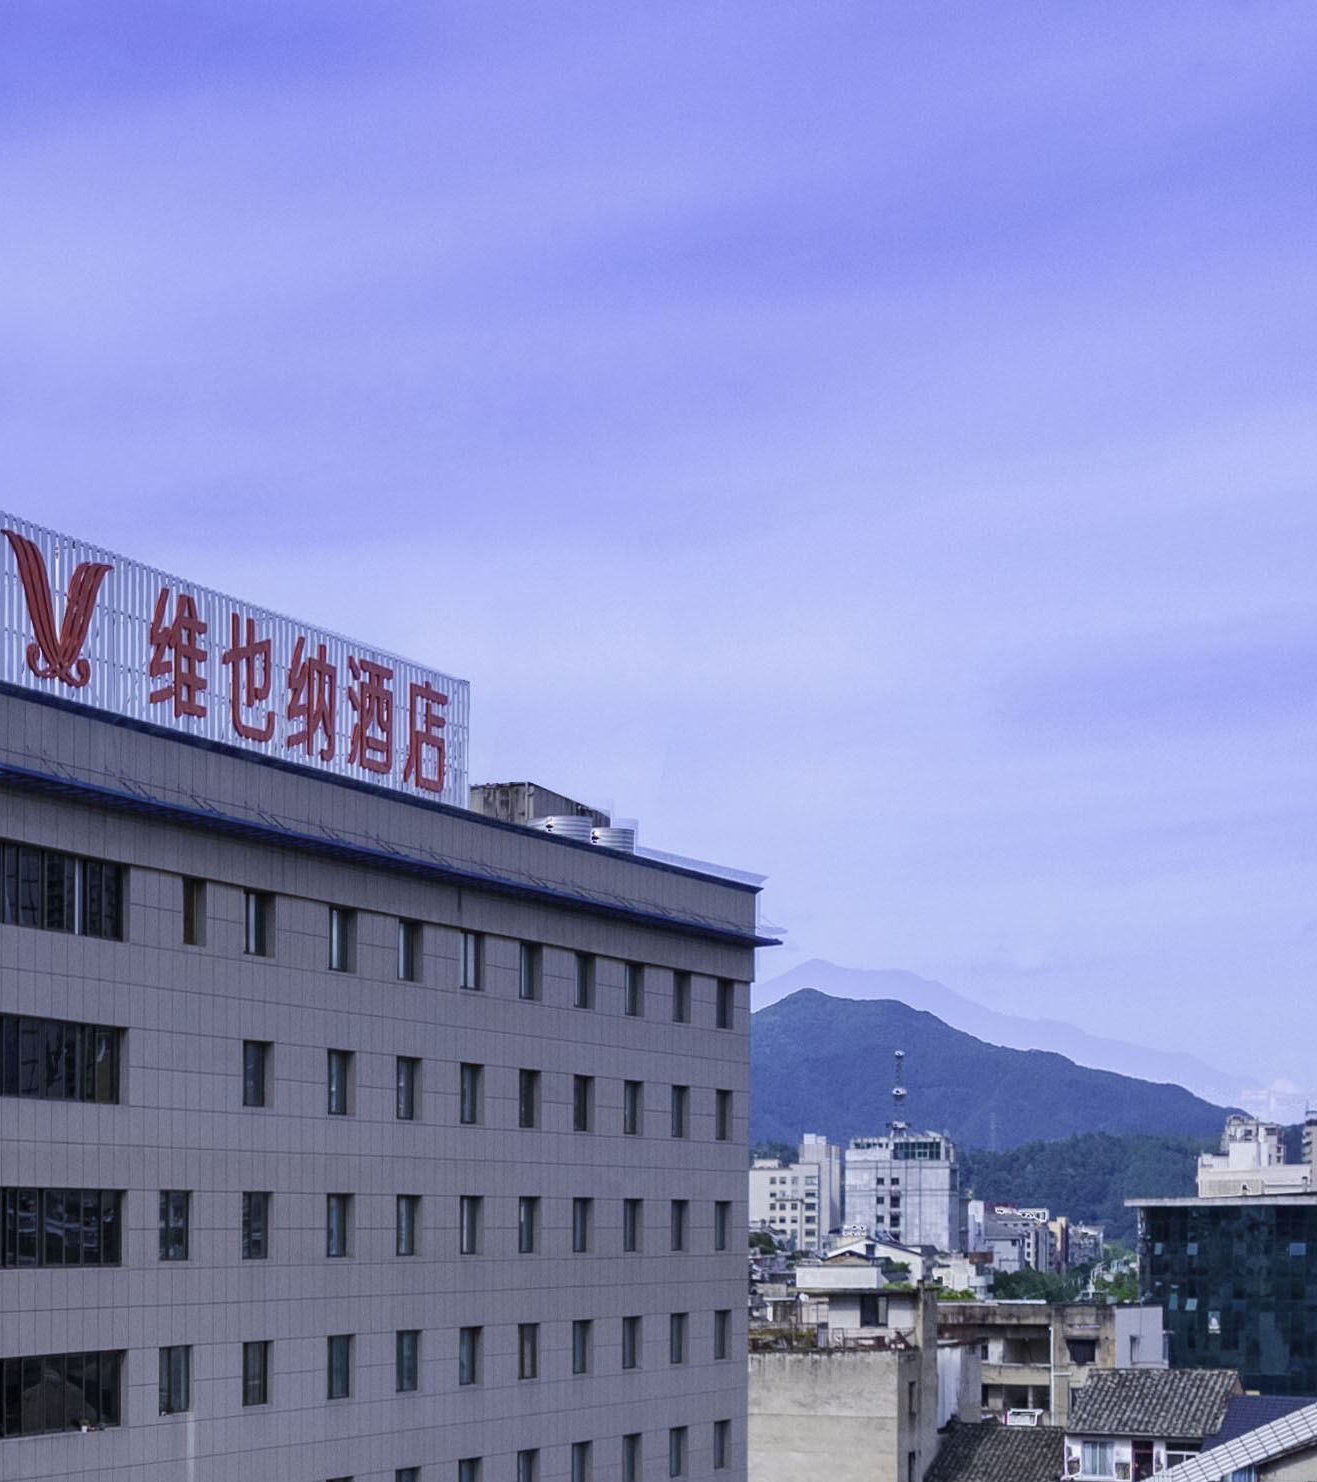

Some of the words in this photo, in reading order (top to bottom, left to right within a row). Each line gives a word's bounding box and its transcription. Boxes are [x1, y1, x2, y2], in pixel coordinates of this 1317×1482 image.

[149, 587, 448, 792] 维也纳酒店
